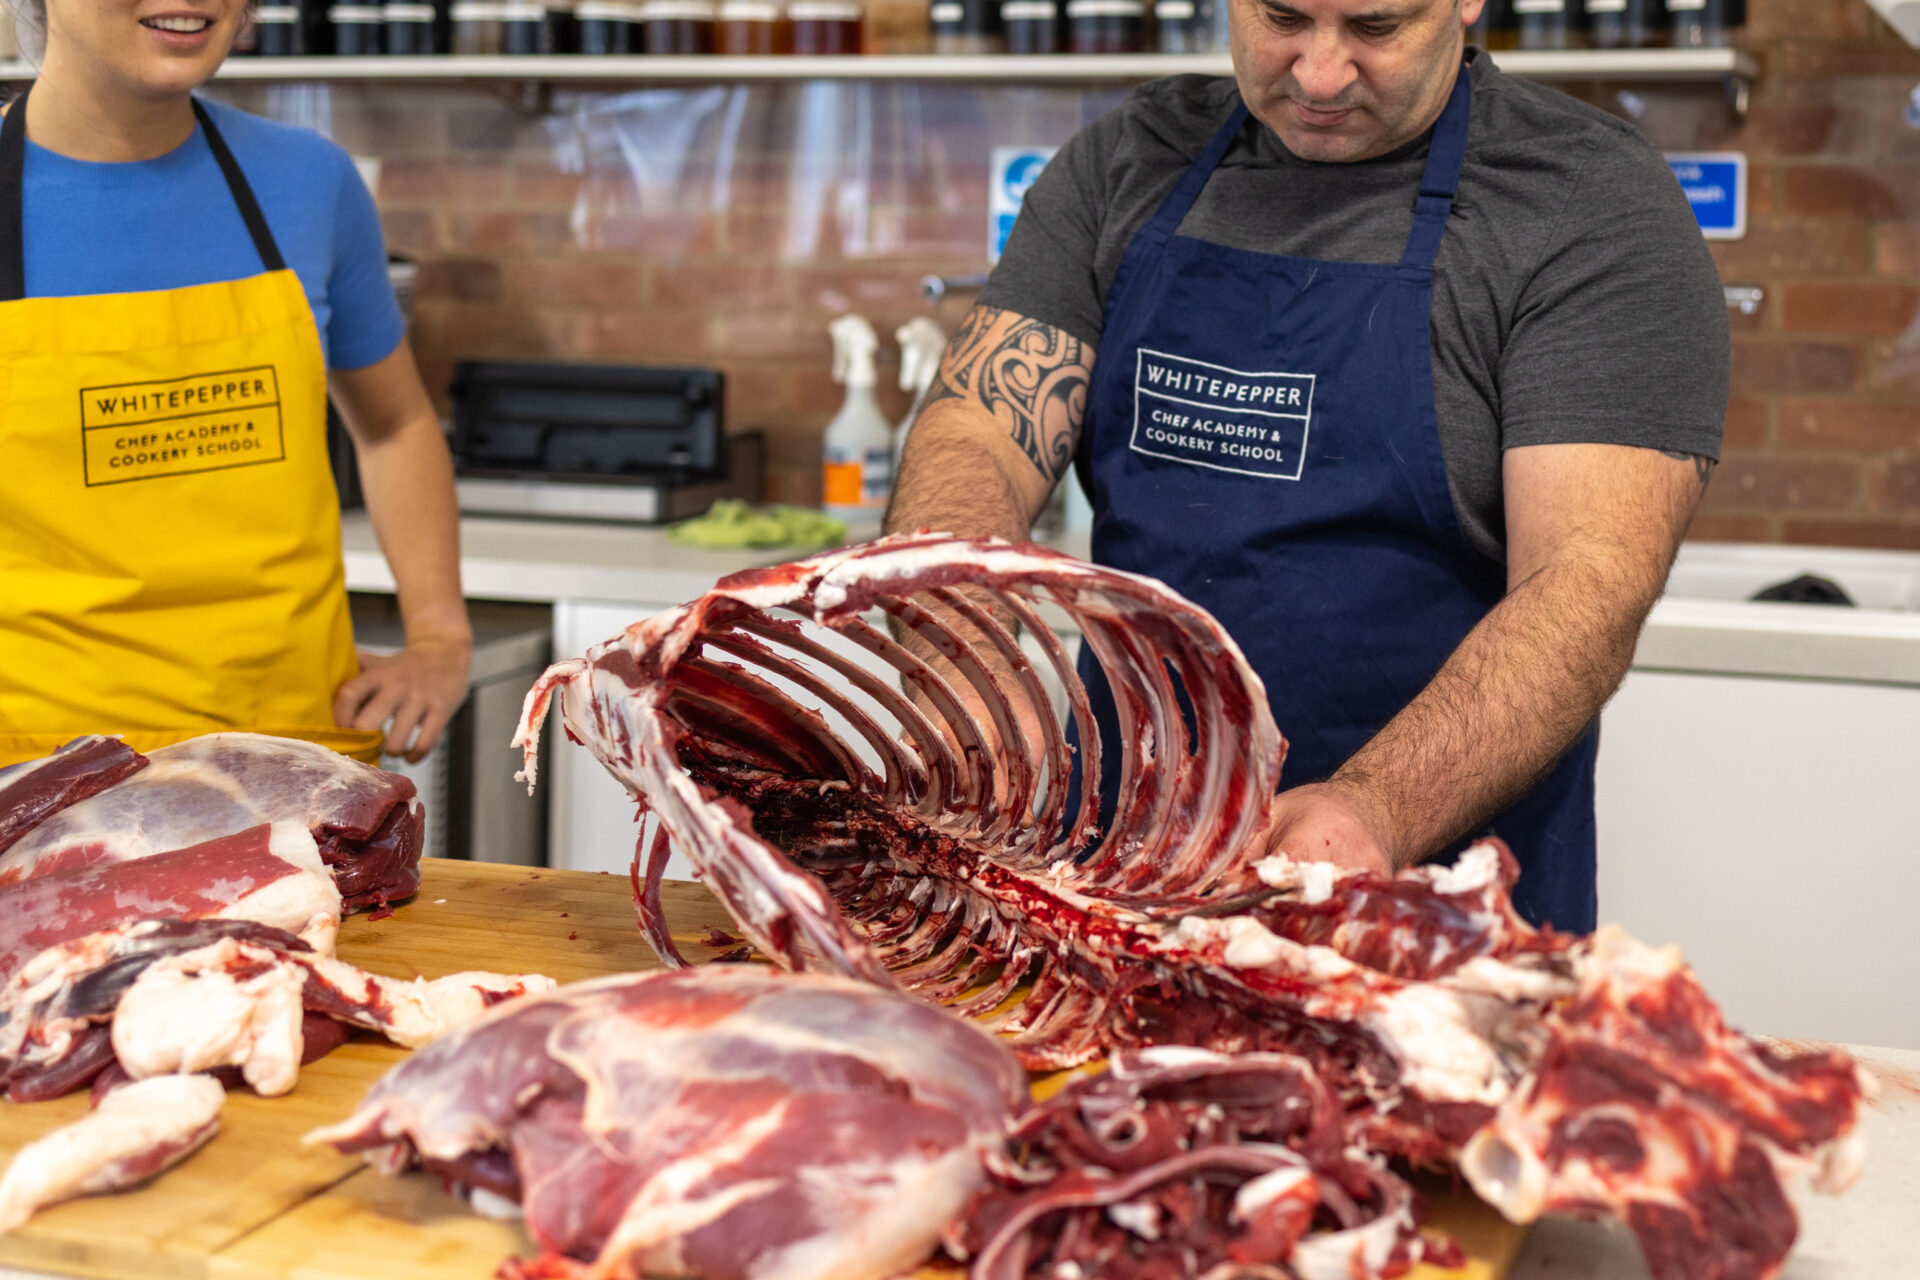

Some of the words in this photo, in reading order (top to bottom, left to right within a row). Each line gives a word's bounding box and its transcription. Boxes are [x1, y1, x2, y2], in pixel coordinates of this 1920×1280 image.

[96, 378, 267, 415] WHITEPEPPER
[1147, 364, 1301, 406] WHITEPEPPER
[115, 433, 159, 450] CHEF
[164, 422, 241, 443] ACADEMY
[1151, 409, 1190, 428] CHEF
[1192, 418, 1268, 441] ACADEMY
[1271, 430, 1281, 443] &
[109, 448, 189, 469] COOKERY
[197, 437, 262, 457] SCHOOL
[1145, 427, 1215, 452] COOKERY
[1219, 442, 1284, 463] SCHOOL
